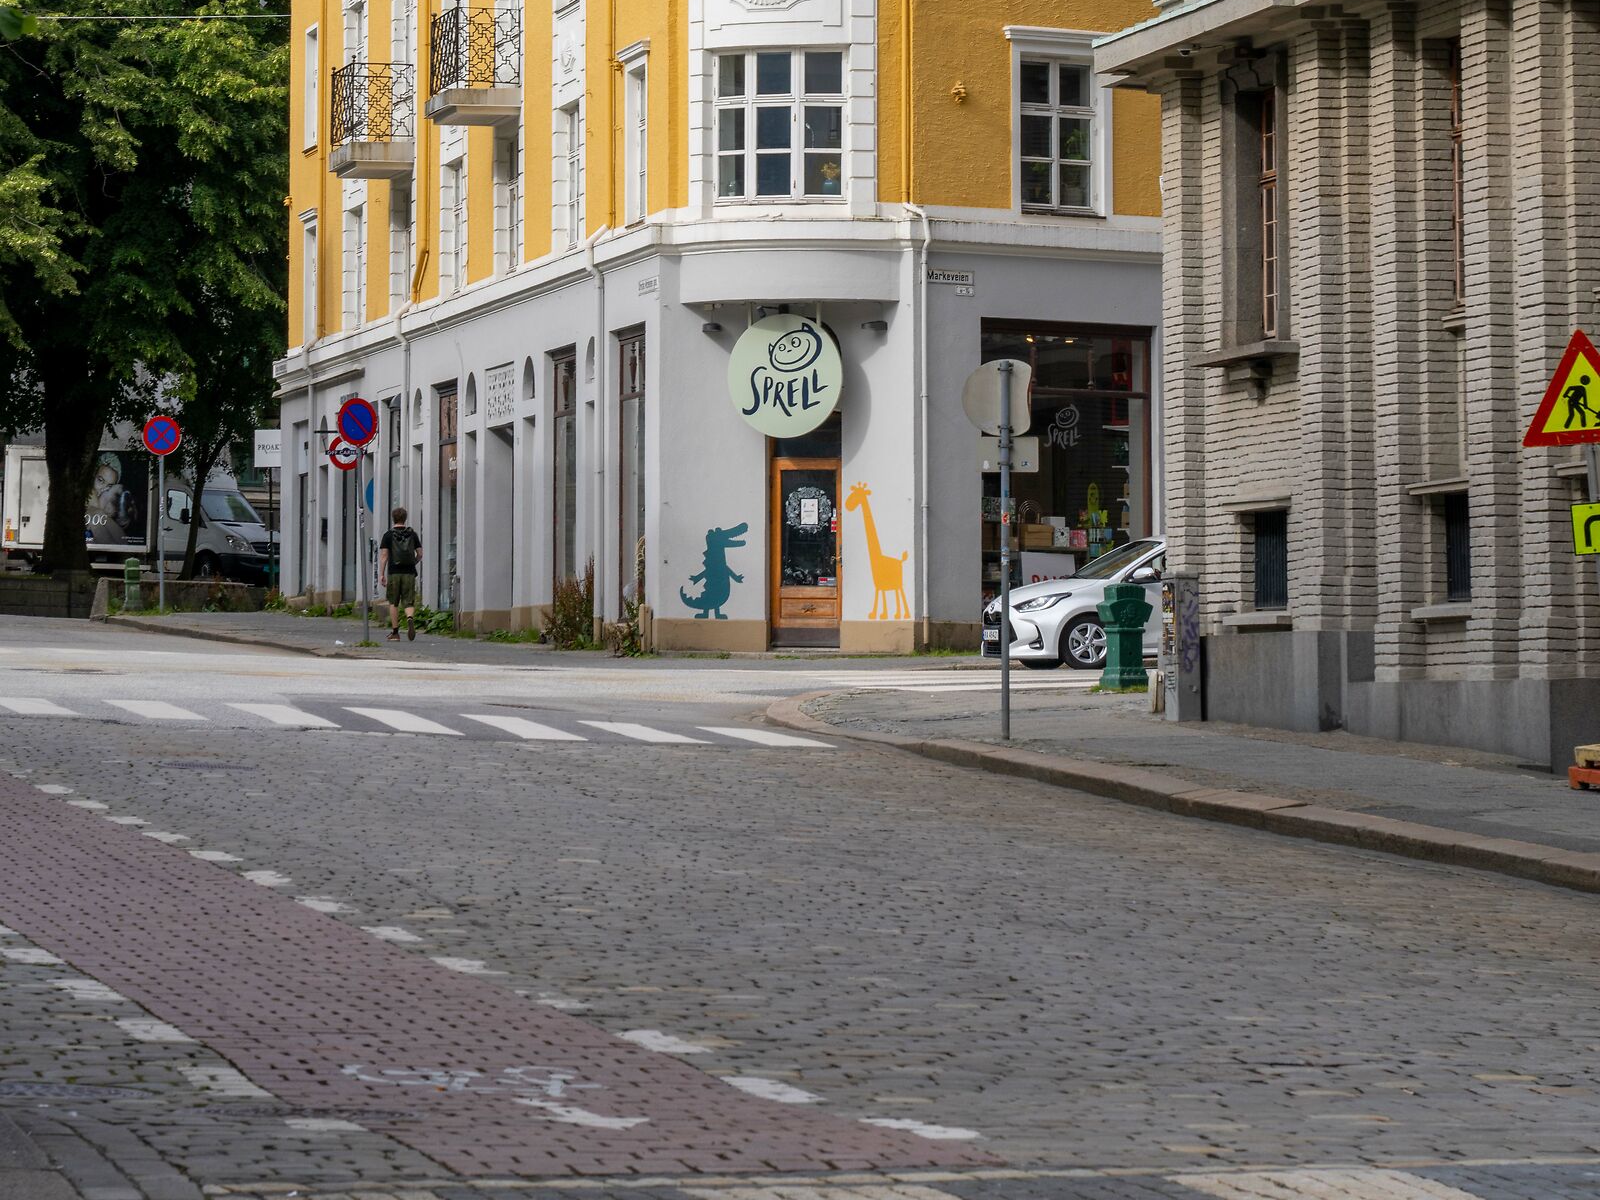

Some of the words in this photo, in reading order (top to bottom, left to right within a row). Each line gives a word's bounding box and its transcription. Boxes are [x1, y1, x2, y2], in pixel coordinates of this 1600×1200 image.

[927, 270, 969, 282] Markeveien
[742, 366, 829, 417] SPRELL
[1043, 423, 1082, 450] SPRELL
[257, 443, 281, 454] PROAK
